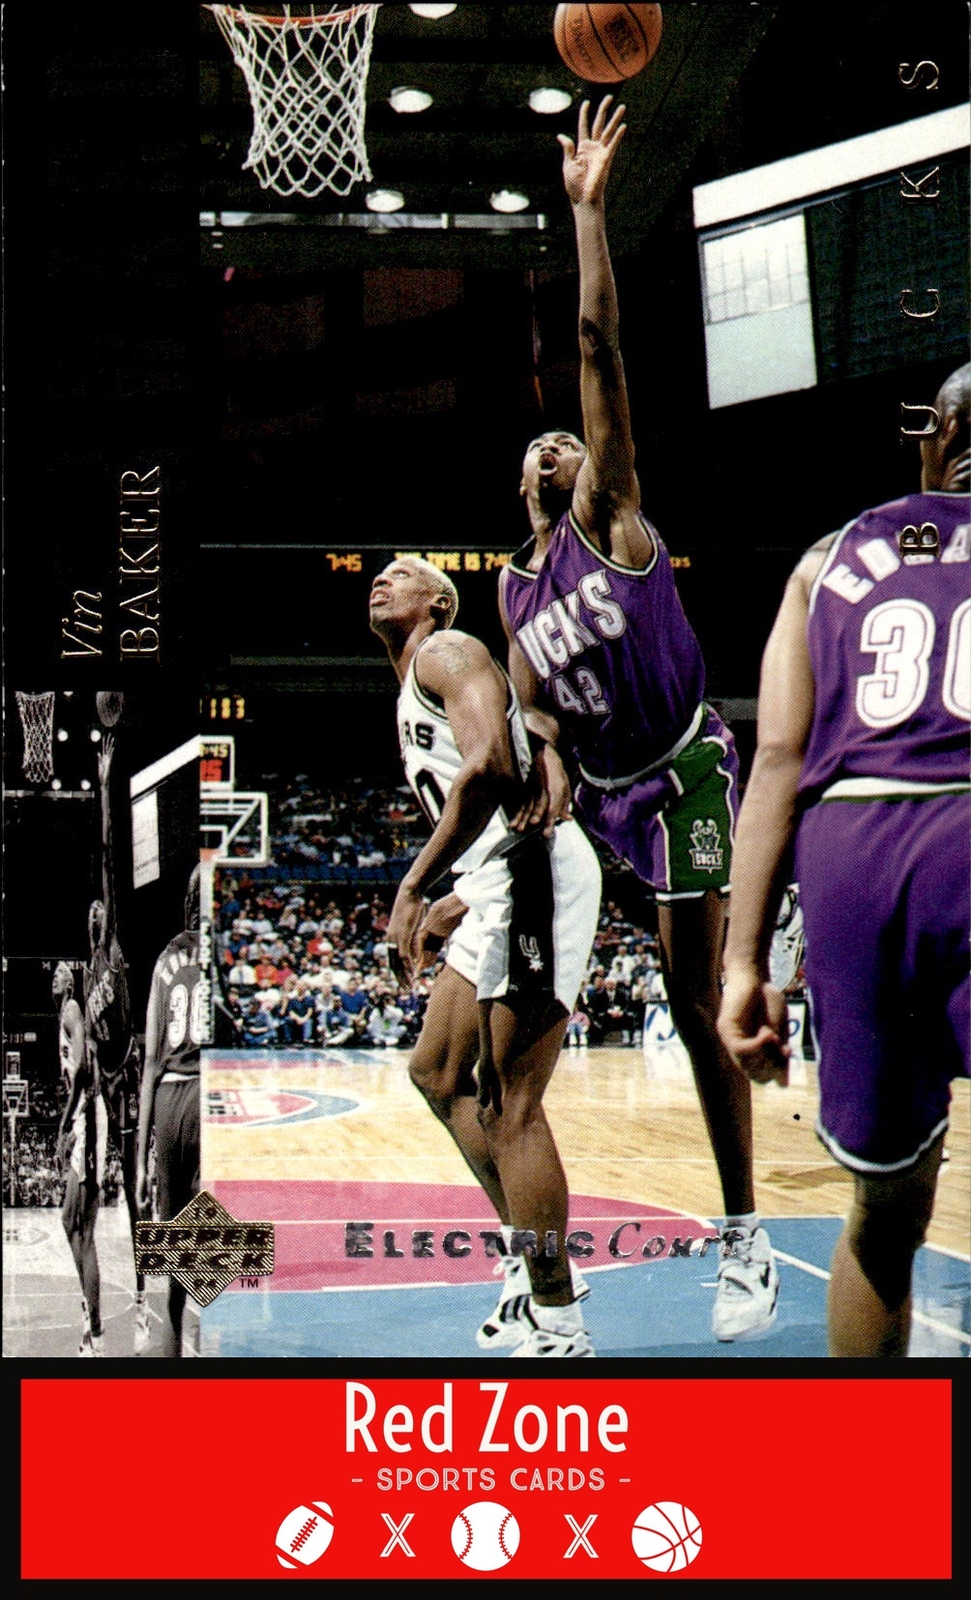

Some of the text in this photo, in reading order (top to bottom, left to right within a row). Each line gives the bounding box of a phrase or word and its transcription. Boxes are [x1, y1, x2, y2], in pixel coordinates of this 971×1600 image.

[119, 465, 161, 664] BAKER
[61, 590, 104, 660] Vin
[516, 569, 626, 680] UCKS
[552, 665, 612, 715] 42
[137, 1228, 271, 1246] UPPER
[607, 1221, 745, 1259] Court
[139, 1252, 268, 1270] DECK
[238, 1278, 260, 1289] TM
